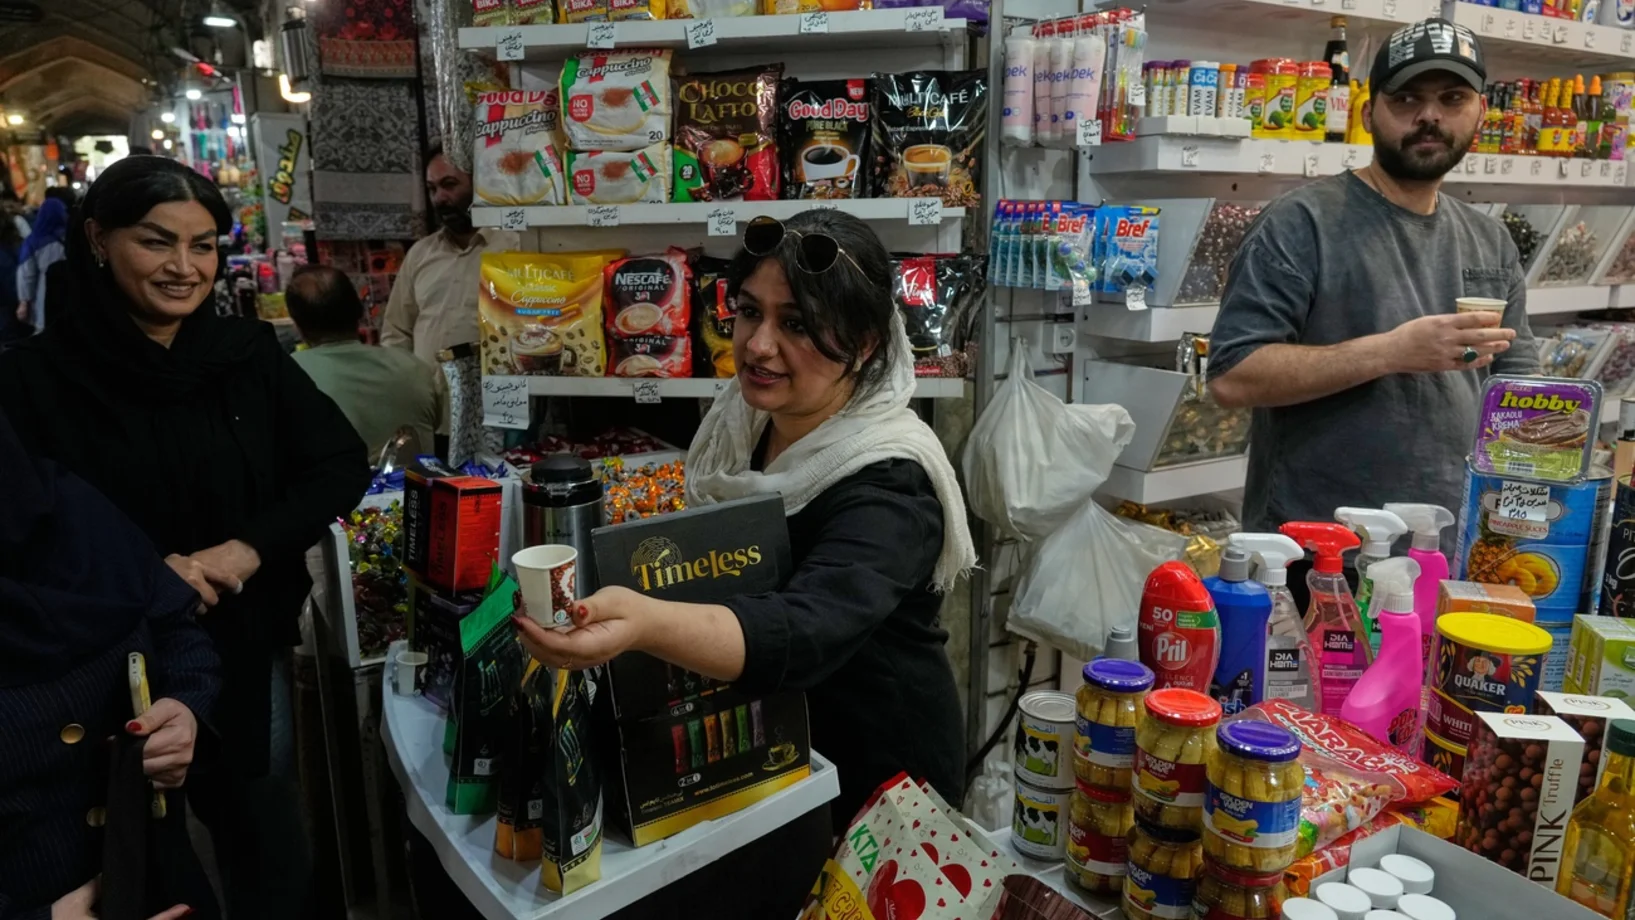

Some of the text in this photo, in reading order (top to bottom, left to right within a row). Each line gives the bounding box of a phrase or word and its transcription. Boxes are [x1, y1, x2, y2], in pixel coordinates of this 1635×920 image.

[577, 57, 652, 78] Cappuccino
[572, 99, 588, 108] NO
[789, 98, 869, 122] Good Day
[1193, 89, 1202, 115] EVAM
[1204, 90, 1214, 116] EVAM
[474, 110, 556, 138] Cappuccino
[648, 131, 663, 140] 20
[1057, 214, 1087, 233] Bref
[1117, 219, 1150, 237] Bref
[511, 290, 566, 307] Cappuccino
[1500, 391, 1581, 414] hobby
[1491, 411, 1523, 420] KAKAOLU
[1508, 507, 1527, 519] ۳۸۵
[407, 489, 420, 562] TIMELESS
[634, 545, 762, 591] Timeless
[1152, 606, 1173, 621] 50
[1330, 634, 1349, 642] DIA
[1156, 637, 1187, 661] Pril
[1454, 674, 1506, 696] QUAKER
[1443, 713, 1472, 732] WHIT
[1530, 757, 1567, 882] PINK Truffle
